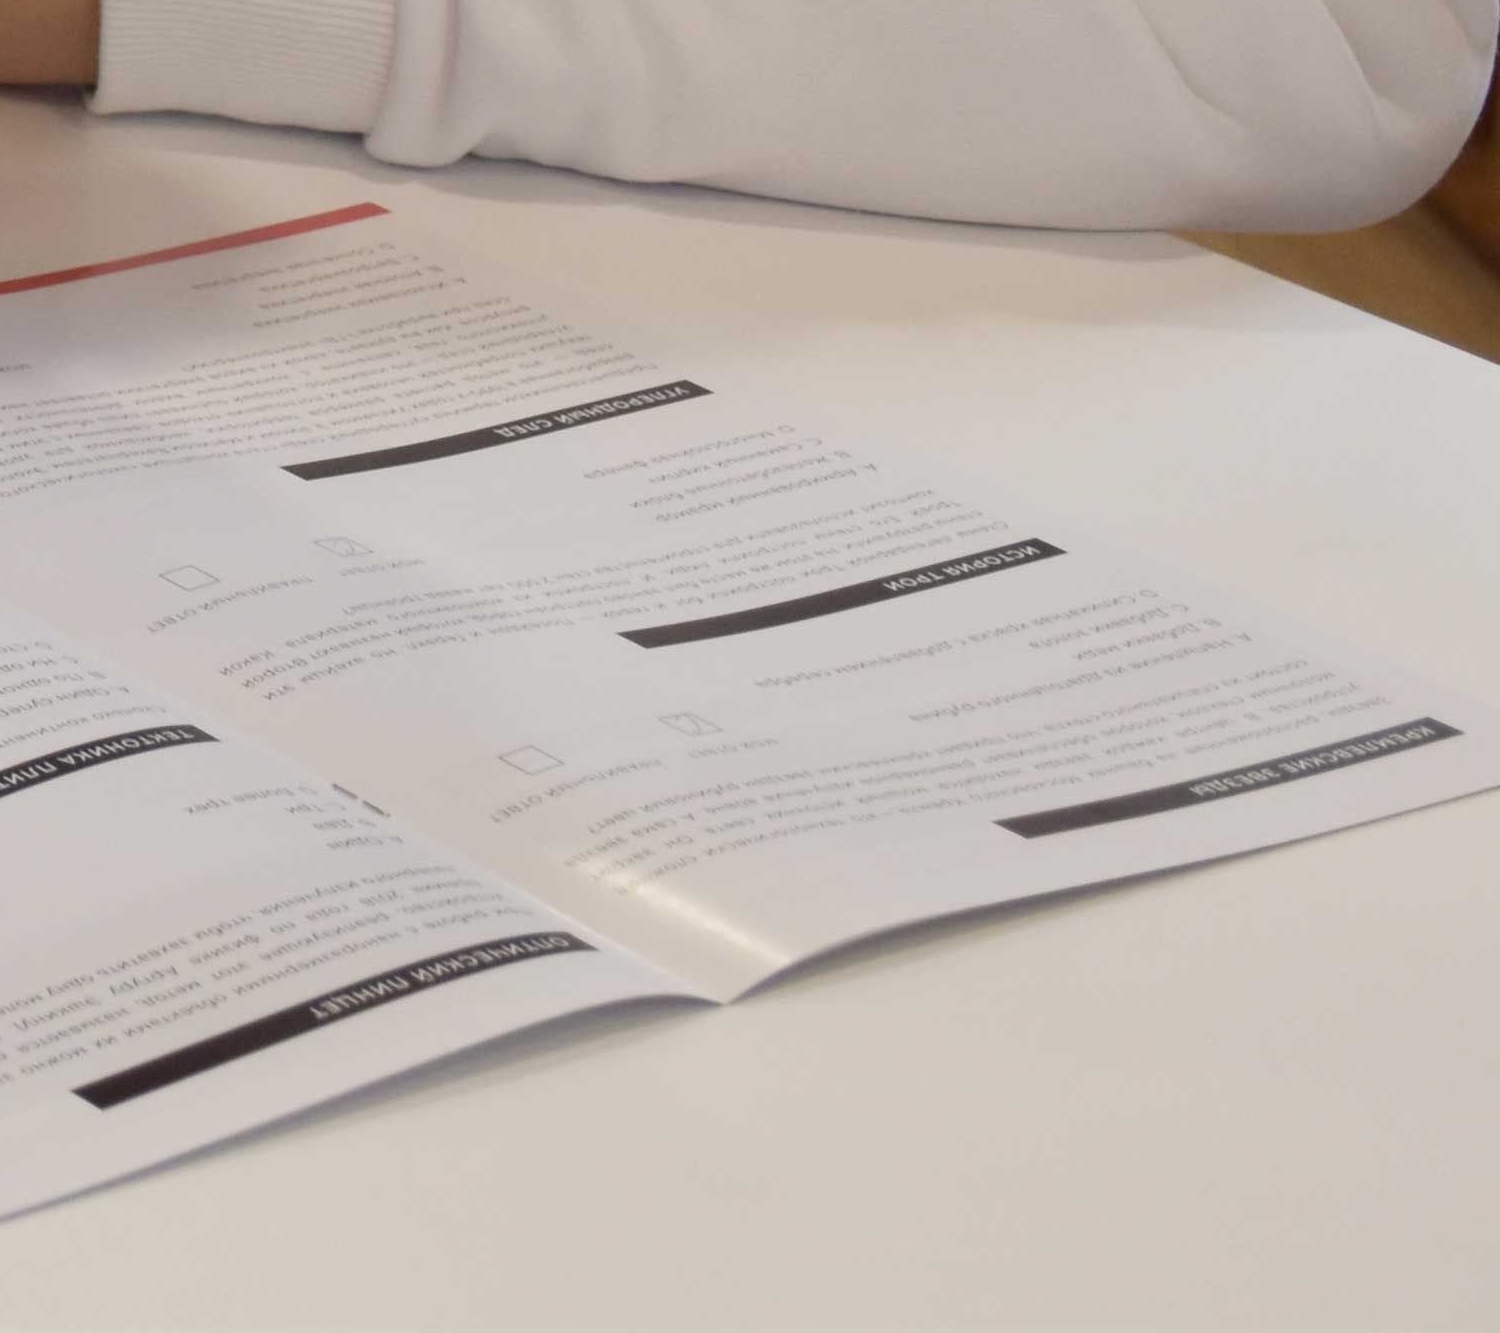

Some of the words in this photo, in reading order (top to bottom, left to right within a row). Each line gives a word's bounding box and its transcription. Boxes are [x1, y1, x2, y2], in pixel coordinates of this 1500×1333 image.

[549, 384, 694, 425] УГЛЕРОДНЫЙ
[489, 416, 555, 437] СЛЕД
[940, 545, 1041, 576] ИСТОРИЯ
[878, 570, 944, 591] ТРОИ
[56, 728, 194, 766] ТЕКТОНИКА
[1277, 725, 1435, 773] КРЕМЛЕВСКИЕ
[1182, 766, 1280, 796] ЗВЕЗДЫ
[408, 935, 569, 983] ОПТИЧЕСКИЙ
[302, 974, 409, 1016] ПИНЦЕТ
